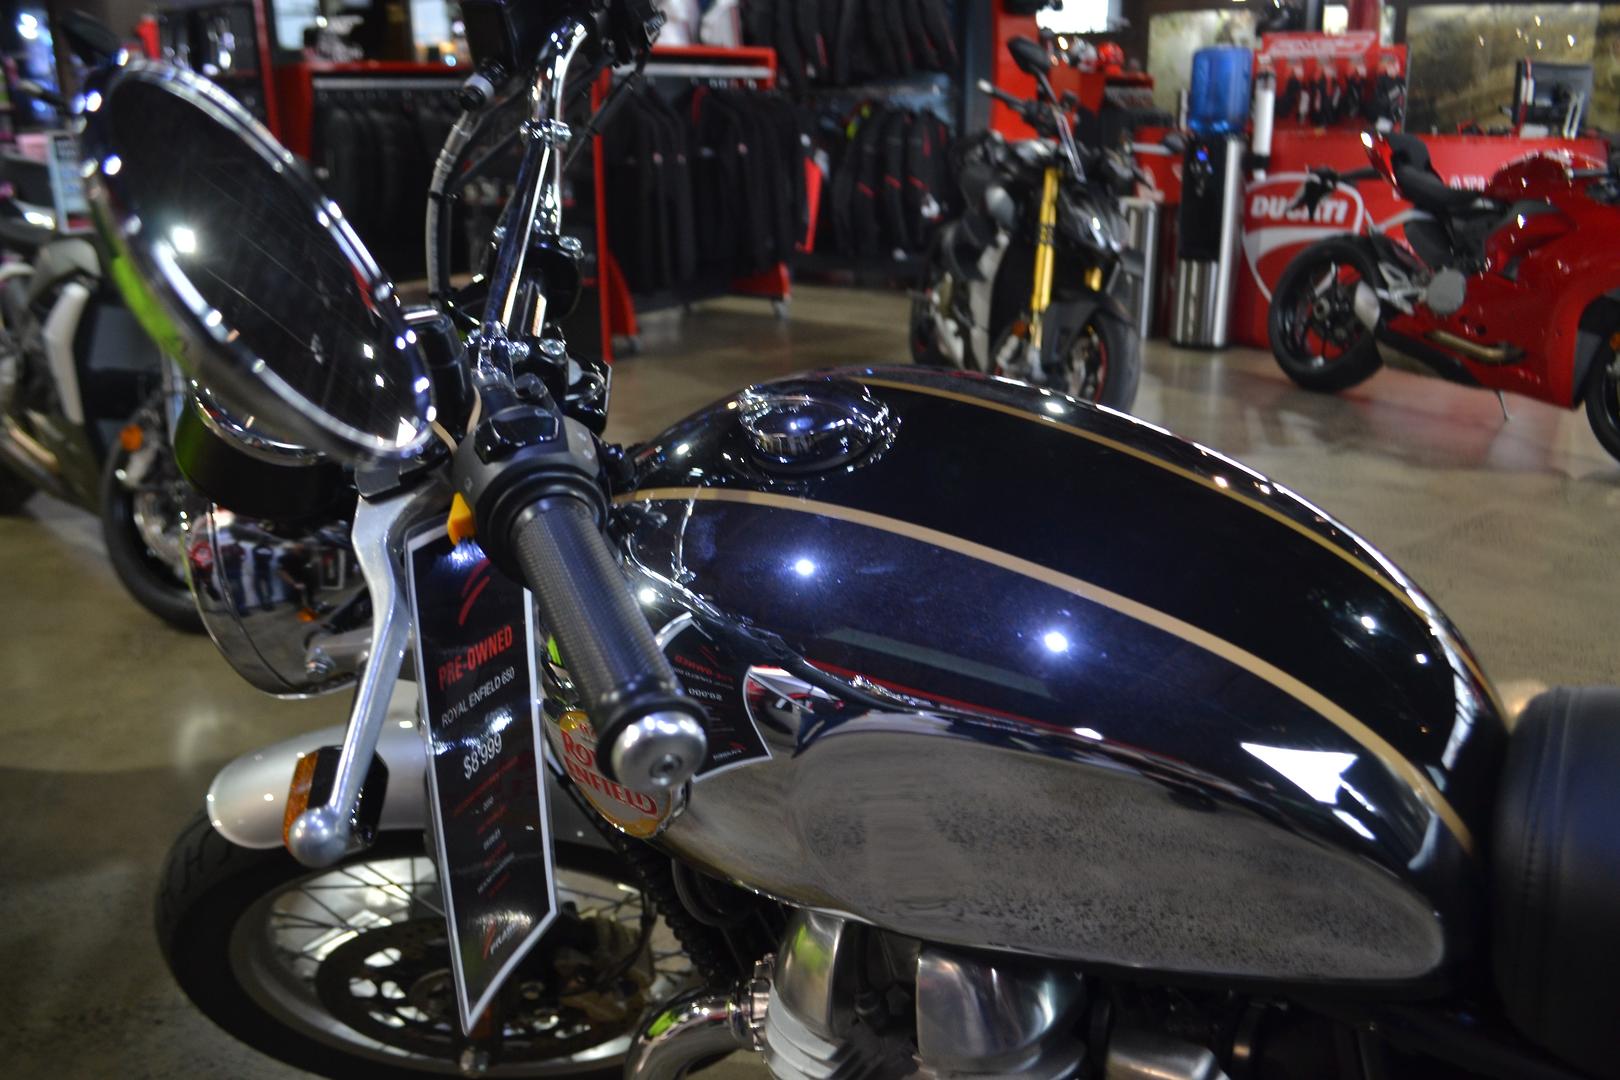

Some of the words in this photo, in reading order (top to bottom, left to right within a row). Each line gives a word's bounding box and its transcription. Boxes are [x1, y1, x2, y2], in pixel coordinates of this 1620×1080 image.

[438, 624, 512, 691] PRE-OWNED
[441, 698, 467, 728] ROYAL
[468, 675, 500, 708] ENFIELD
[501, 666, 515, 685] 650
[564, 755, 658, 816] ENFIELD
